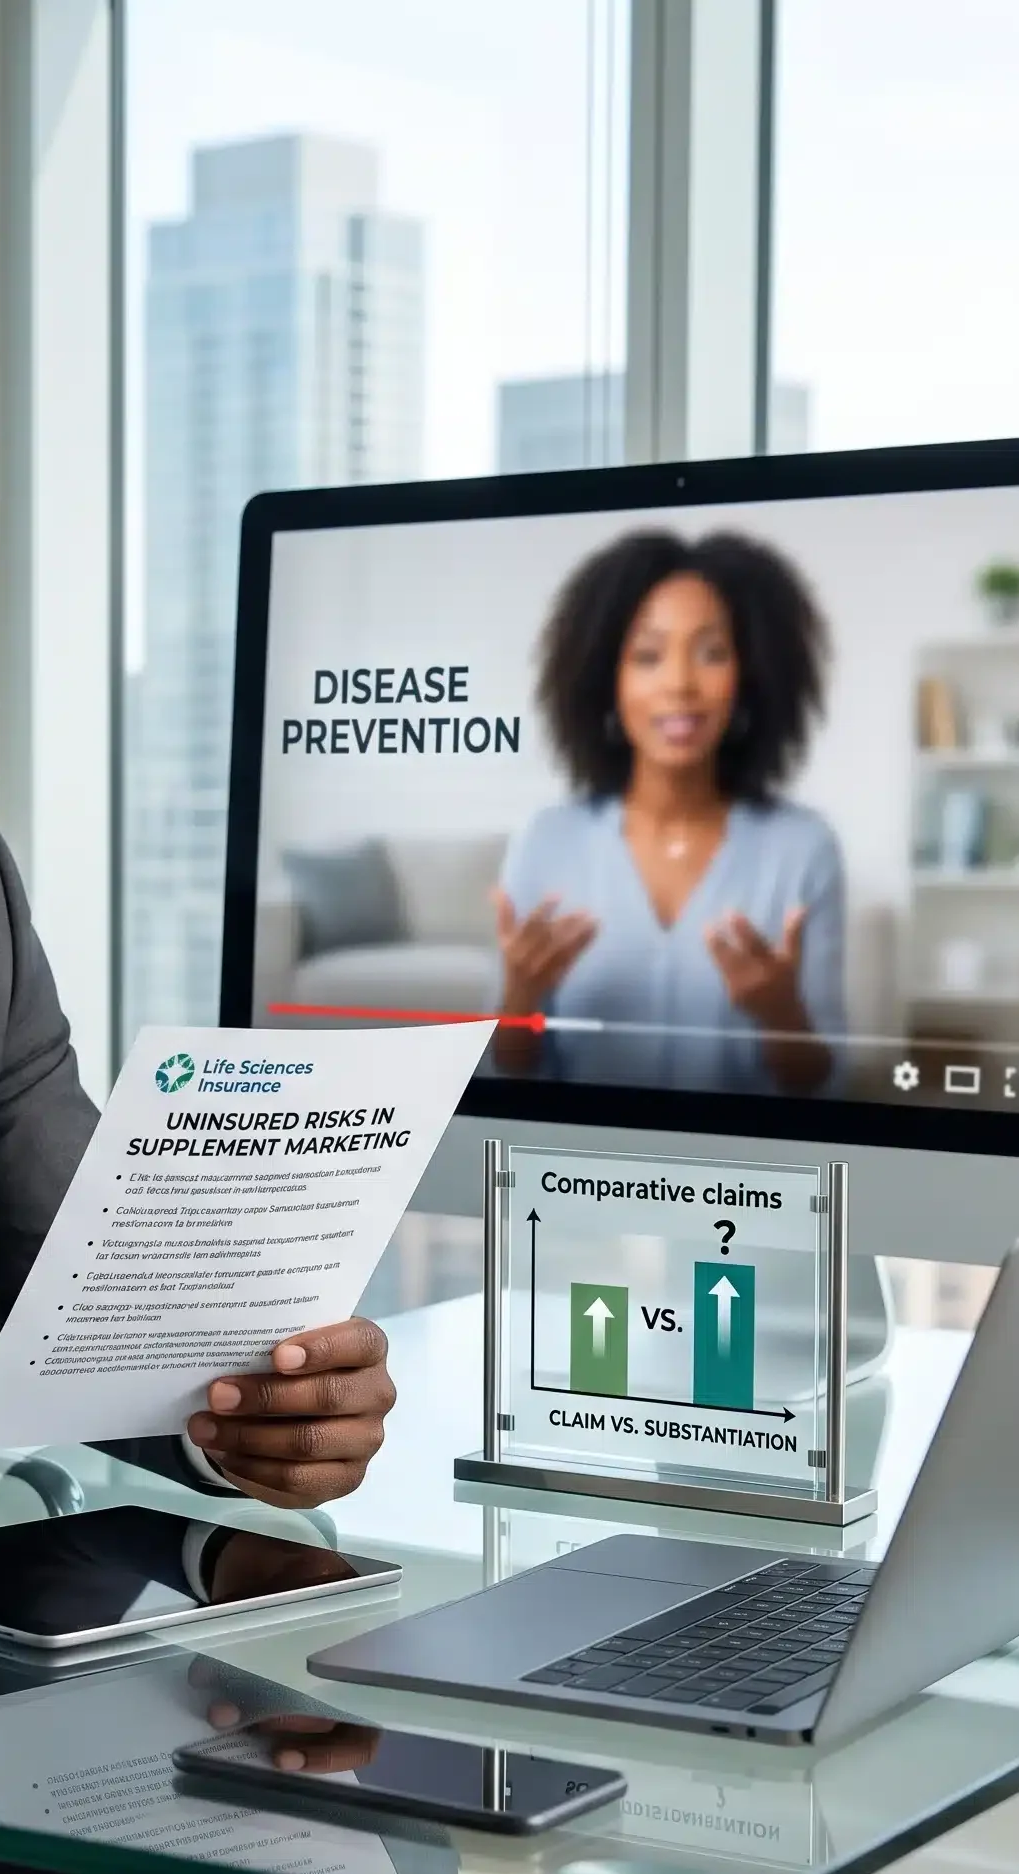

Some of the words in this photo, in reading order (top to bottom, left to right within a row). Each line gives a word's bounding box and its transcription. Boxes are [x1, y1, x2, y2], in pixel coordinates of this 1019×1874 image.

[314, 665, 469, 705] DISEASE
[282, 716, 521, 755] PREVENTION
[202, 1058, 236, 1075] Life
[238, 1059, 314, 1075] Sciences
[197, 1077, 281, 1093] Insurance
[166, 1112, 300, 1131] UNINSURED
[304, 1108, 366, 1129] RISKS
[370, 1107, 396, 1126] IN
[126, 1137, 281, 1157] SUPPLEMENT
[284, 1130, 411, 1155] MARKETING
[541, 1171, 696, 1203] Comparative
[702, 1182, 783, 1210] claims
[713, 1219, 736, 1256] ?
[640, 1306, 683, 1333] VS.
[549, 1409, 605, 1431] CLAIM
[610, 1415, 639, 1435] VS.
[644, 1419, 797, 1453] SUBSTANTIATION
